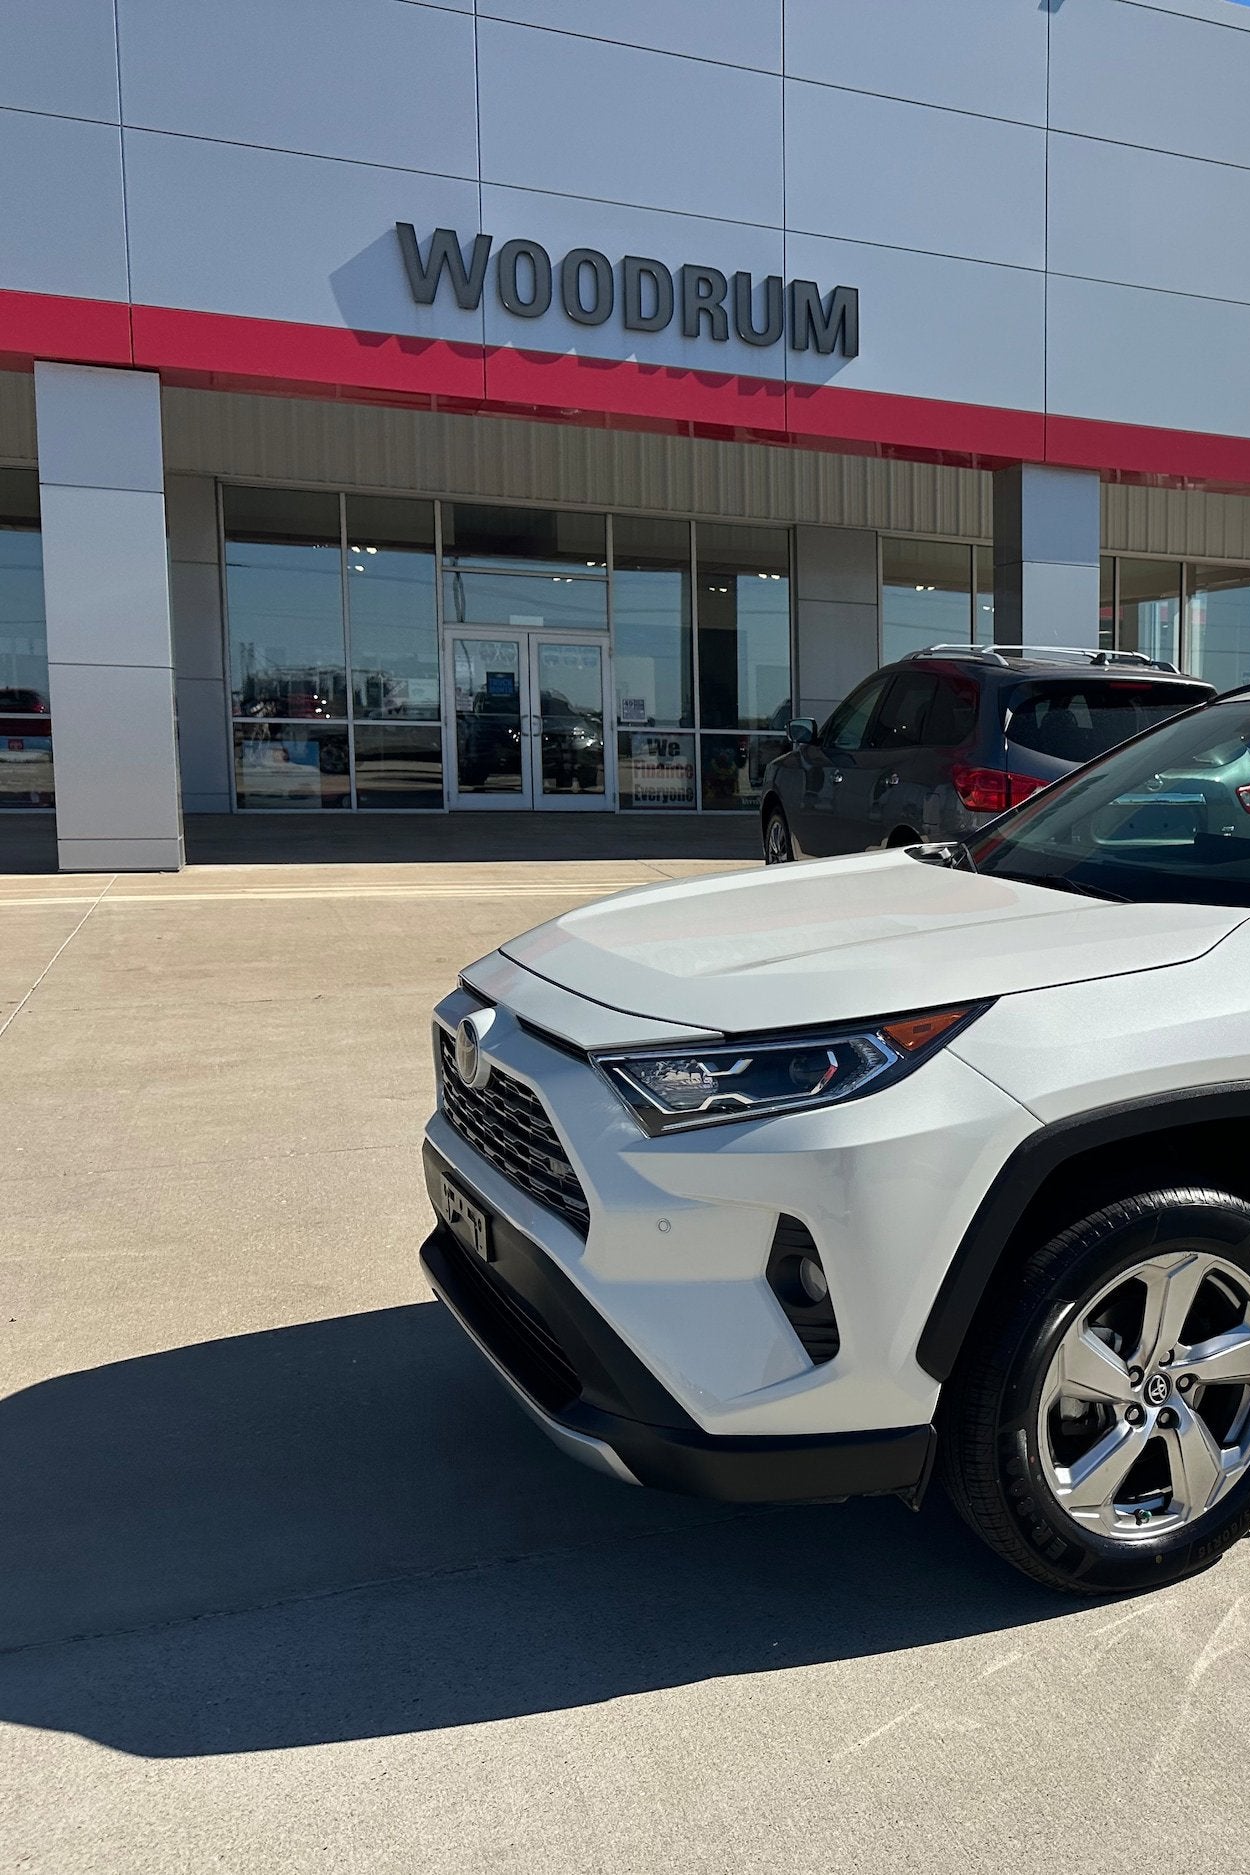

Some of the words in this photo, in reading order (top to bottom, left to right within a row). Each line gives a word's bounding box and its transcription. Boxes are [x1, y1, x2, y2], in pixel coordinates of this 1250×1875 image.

[396, 221, 860, 358] WOODRUM
[647, 739, 681, 757] We
[633, 762, 694, 779] Finance
[634, 784, 694, 803] Everyone
